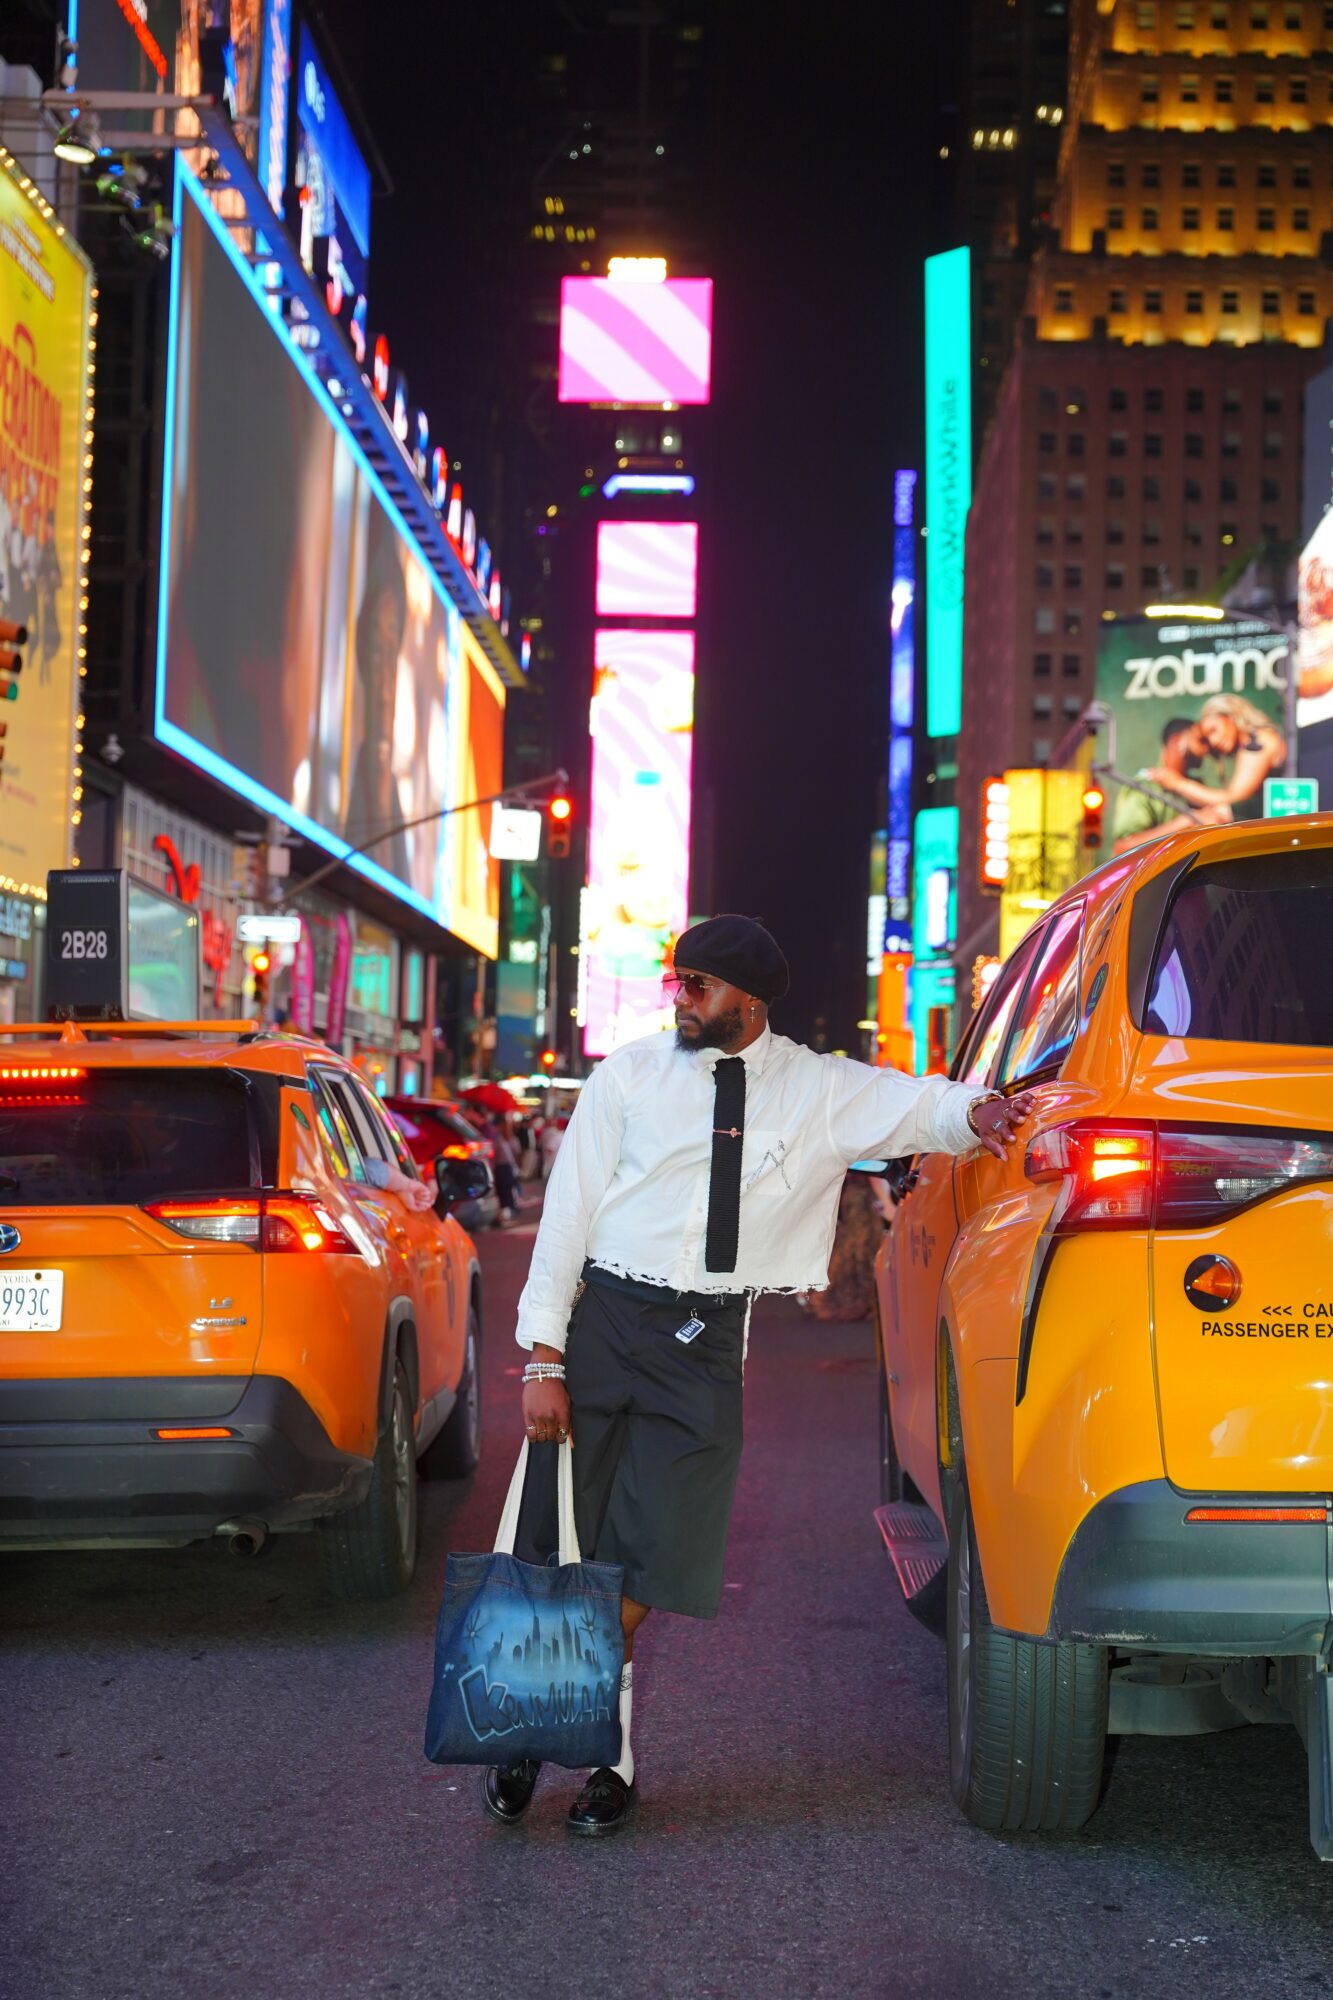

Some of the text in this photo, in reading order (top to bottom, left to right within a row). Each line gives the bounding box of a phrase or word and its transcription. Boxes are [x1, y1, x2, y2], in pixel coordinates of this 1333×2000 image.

[61, 931, 108, 959] 2B28
[3, 1275, 32, 1284] YORK
[1202, 1321, 1309, 1338] PASSENGER
